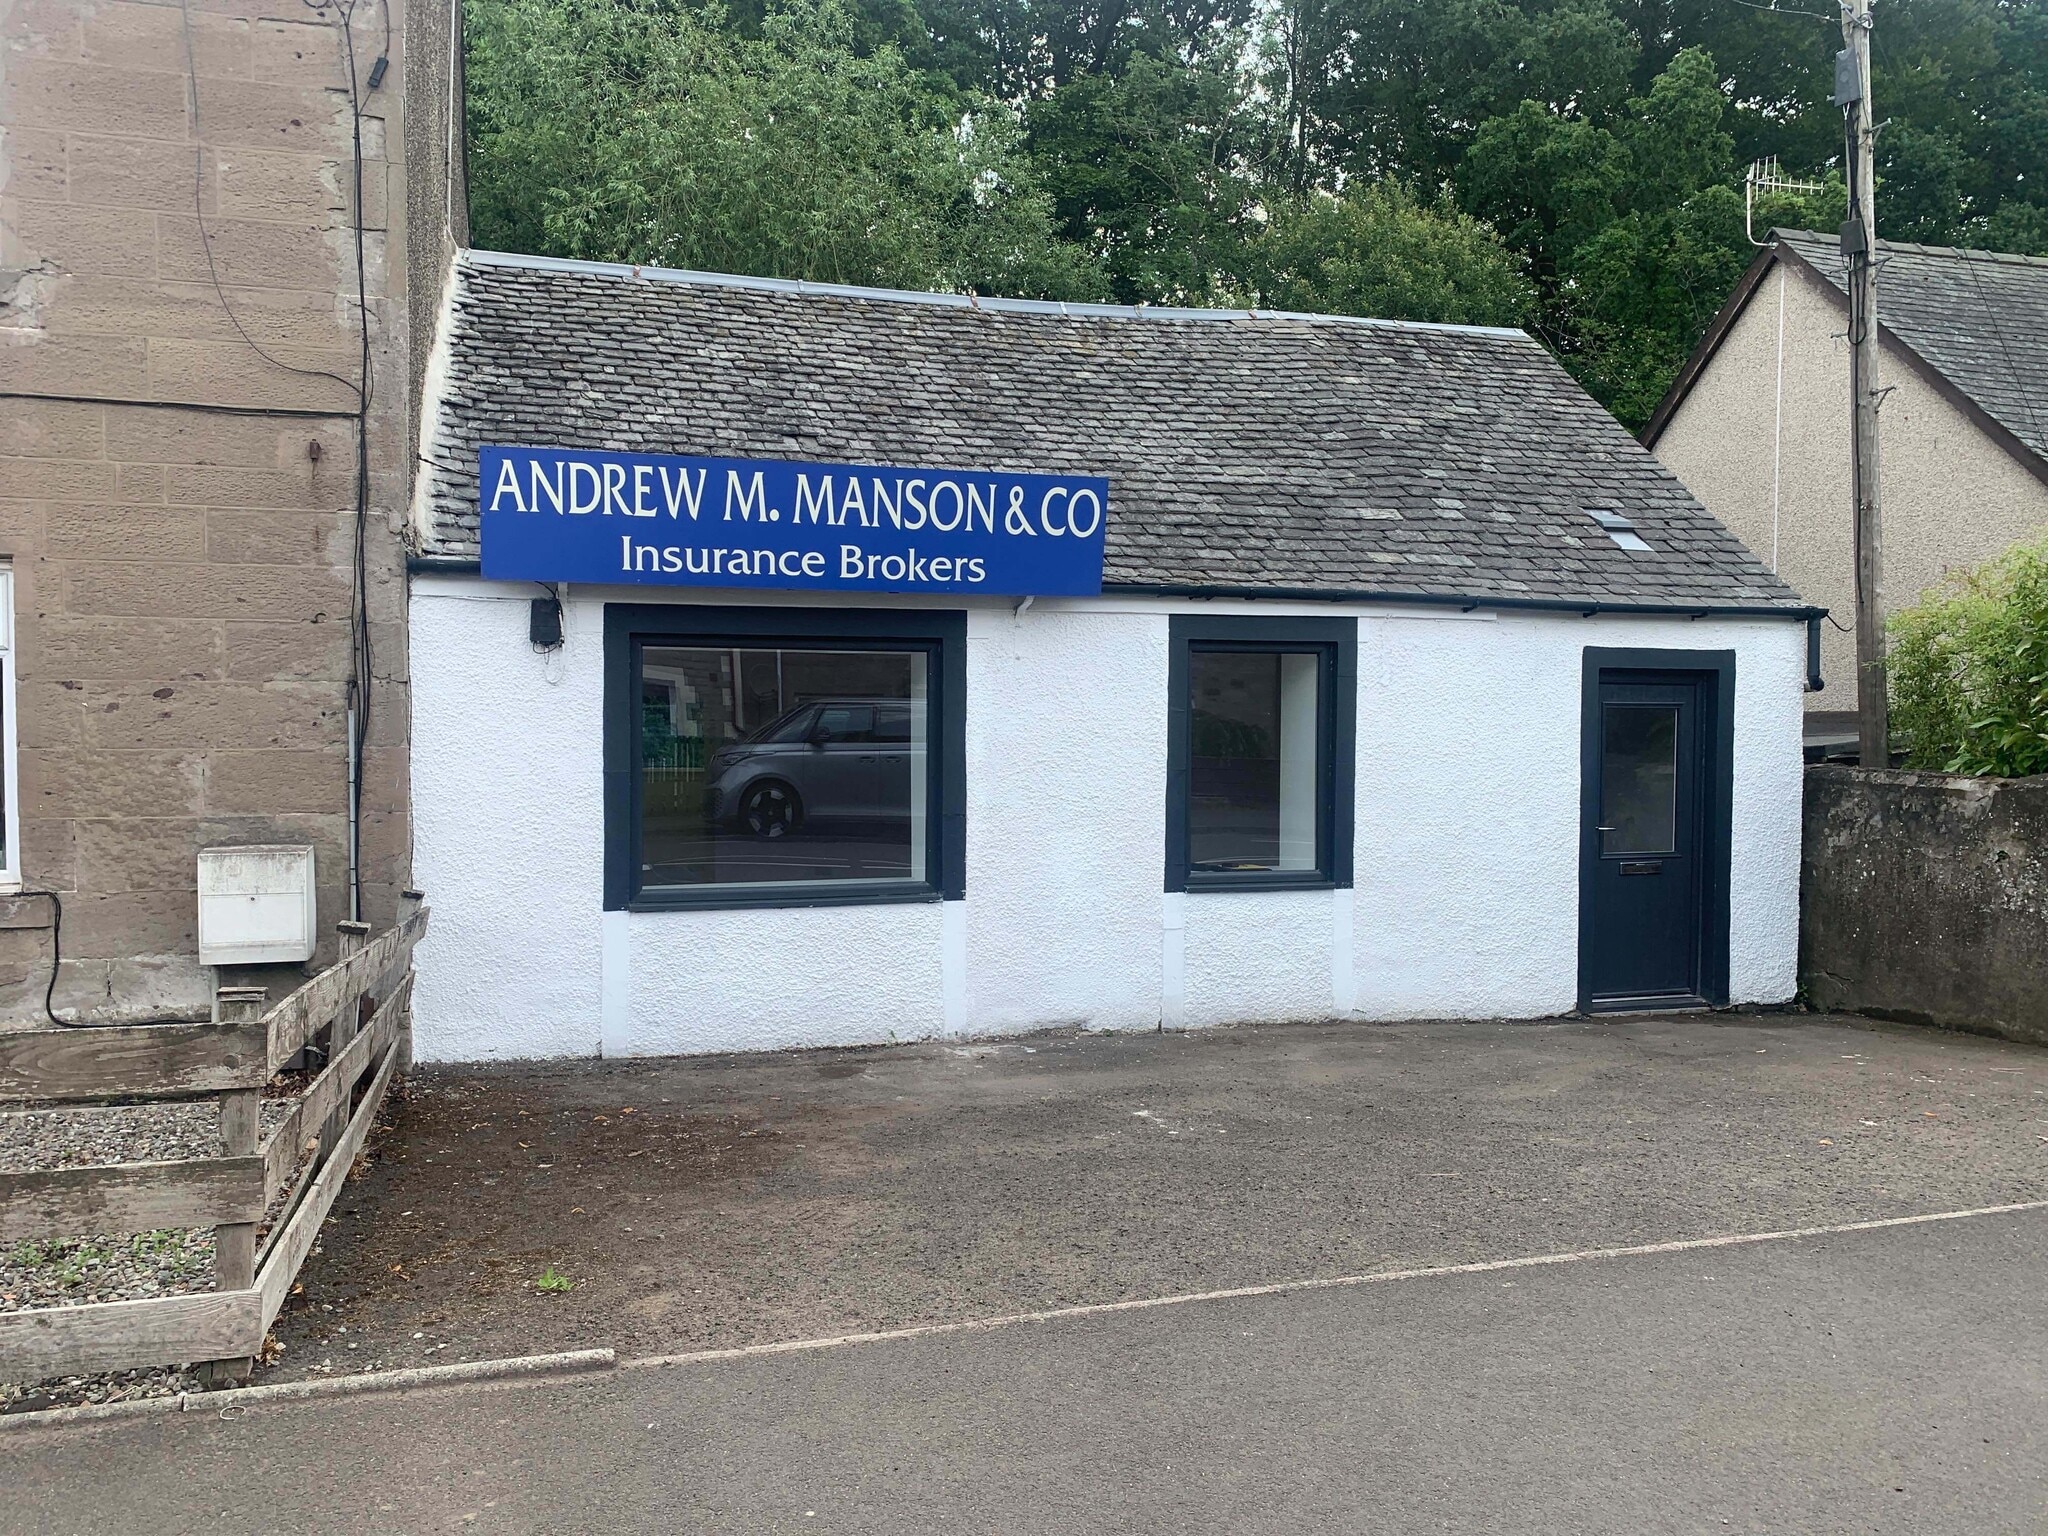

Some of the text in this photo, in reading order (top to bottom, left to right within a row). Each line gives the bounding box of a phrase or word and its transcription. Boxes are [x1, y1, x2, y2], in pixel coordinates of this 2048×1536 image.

[489, 458, 707, 521] ANDREW
[722, 470, 780, 523] M.
[621, 535, 987, 583] Insurance Brokers
